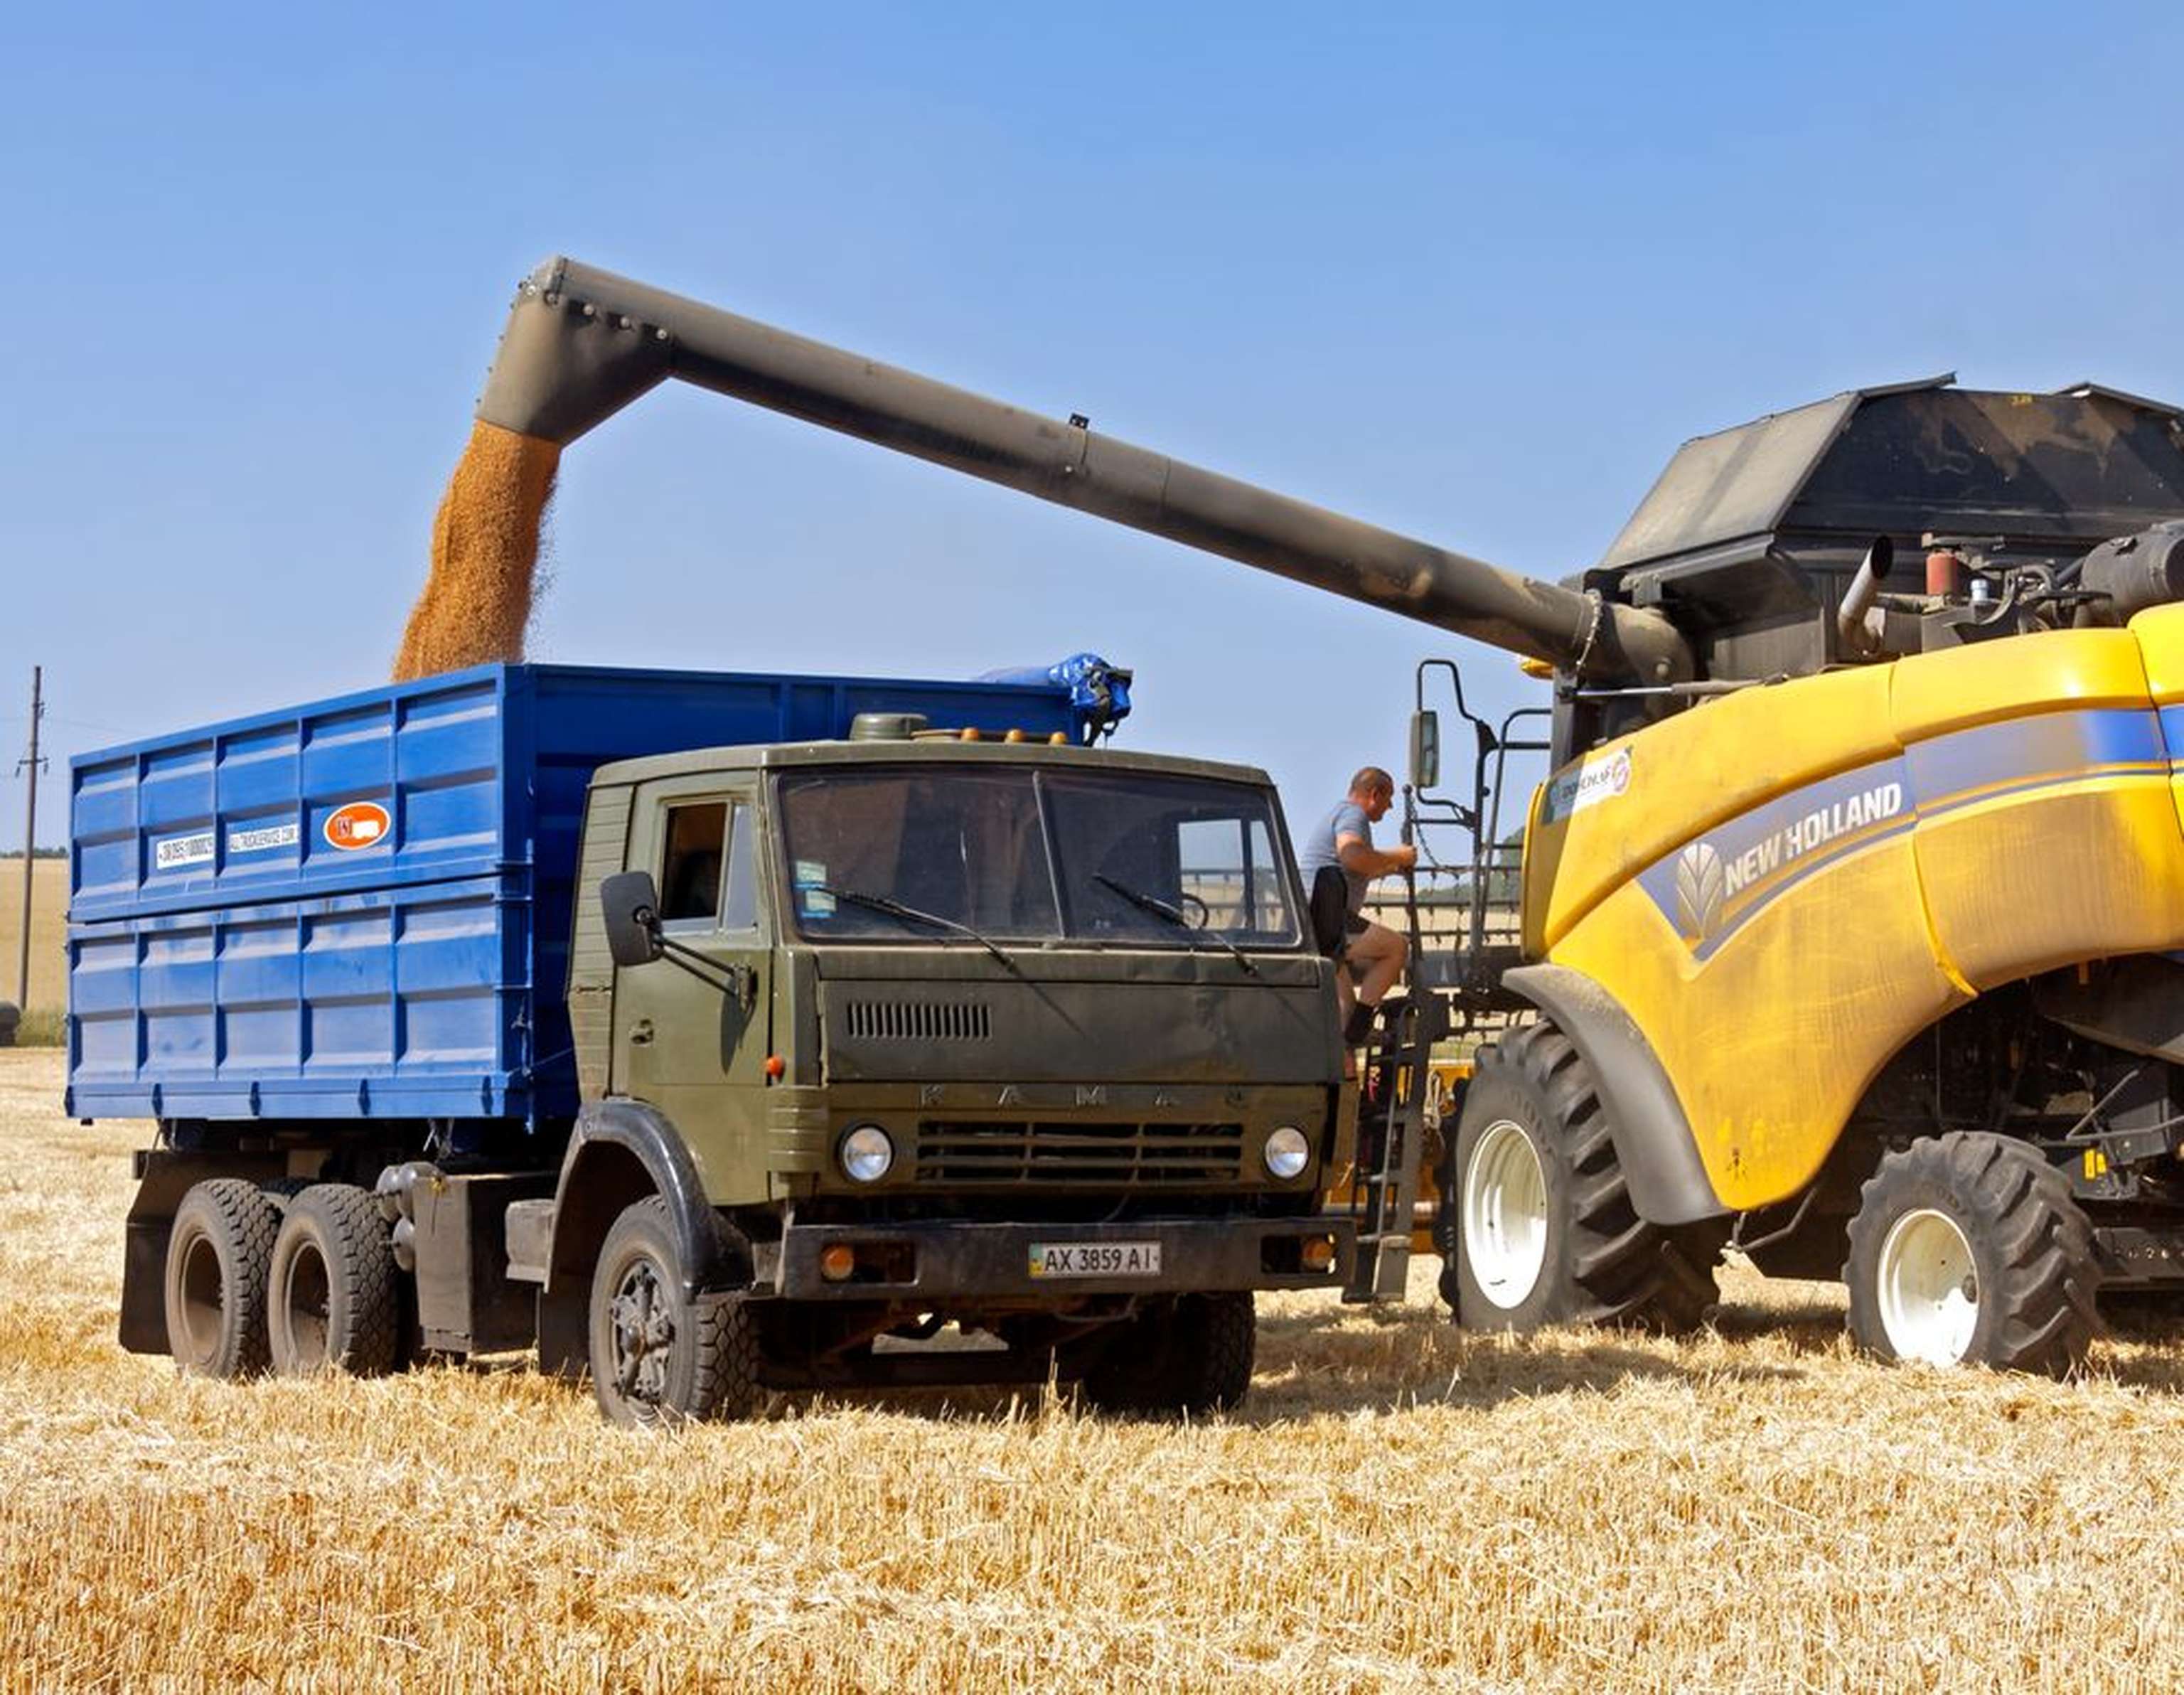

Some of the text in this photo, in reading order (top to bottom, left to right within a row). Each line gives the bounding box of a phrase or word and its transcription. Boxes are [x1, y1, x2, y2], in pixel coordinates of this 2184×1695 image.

[1725, 782, 1902, 897] NEW HOLLAND
[1045, 1248, 1150, 1271] AX 3859 AI
